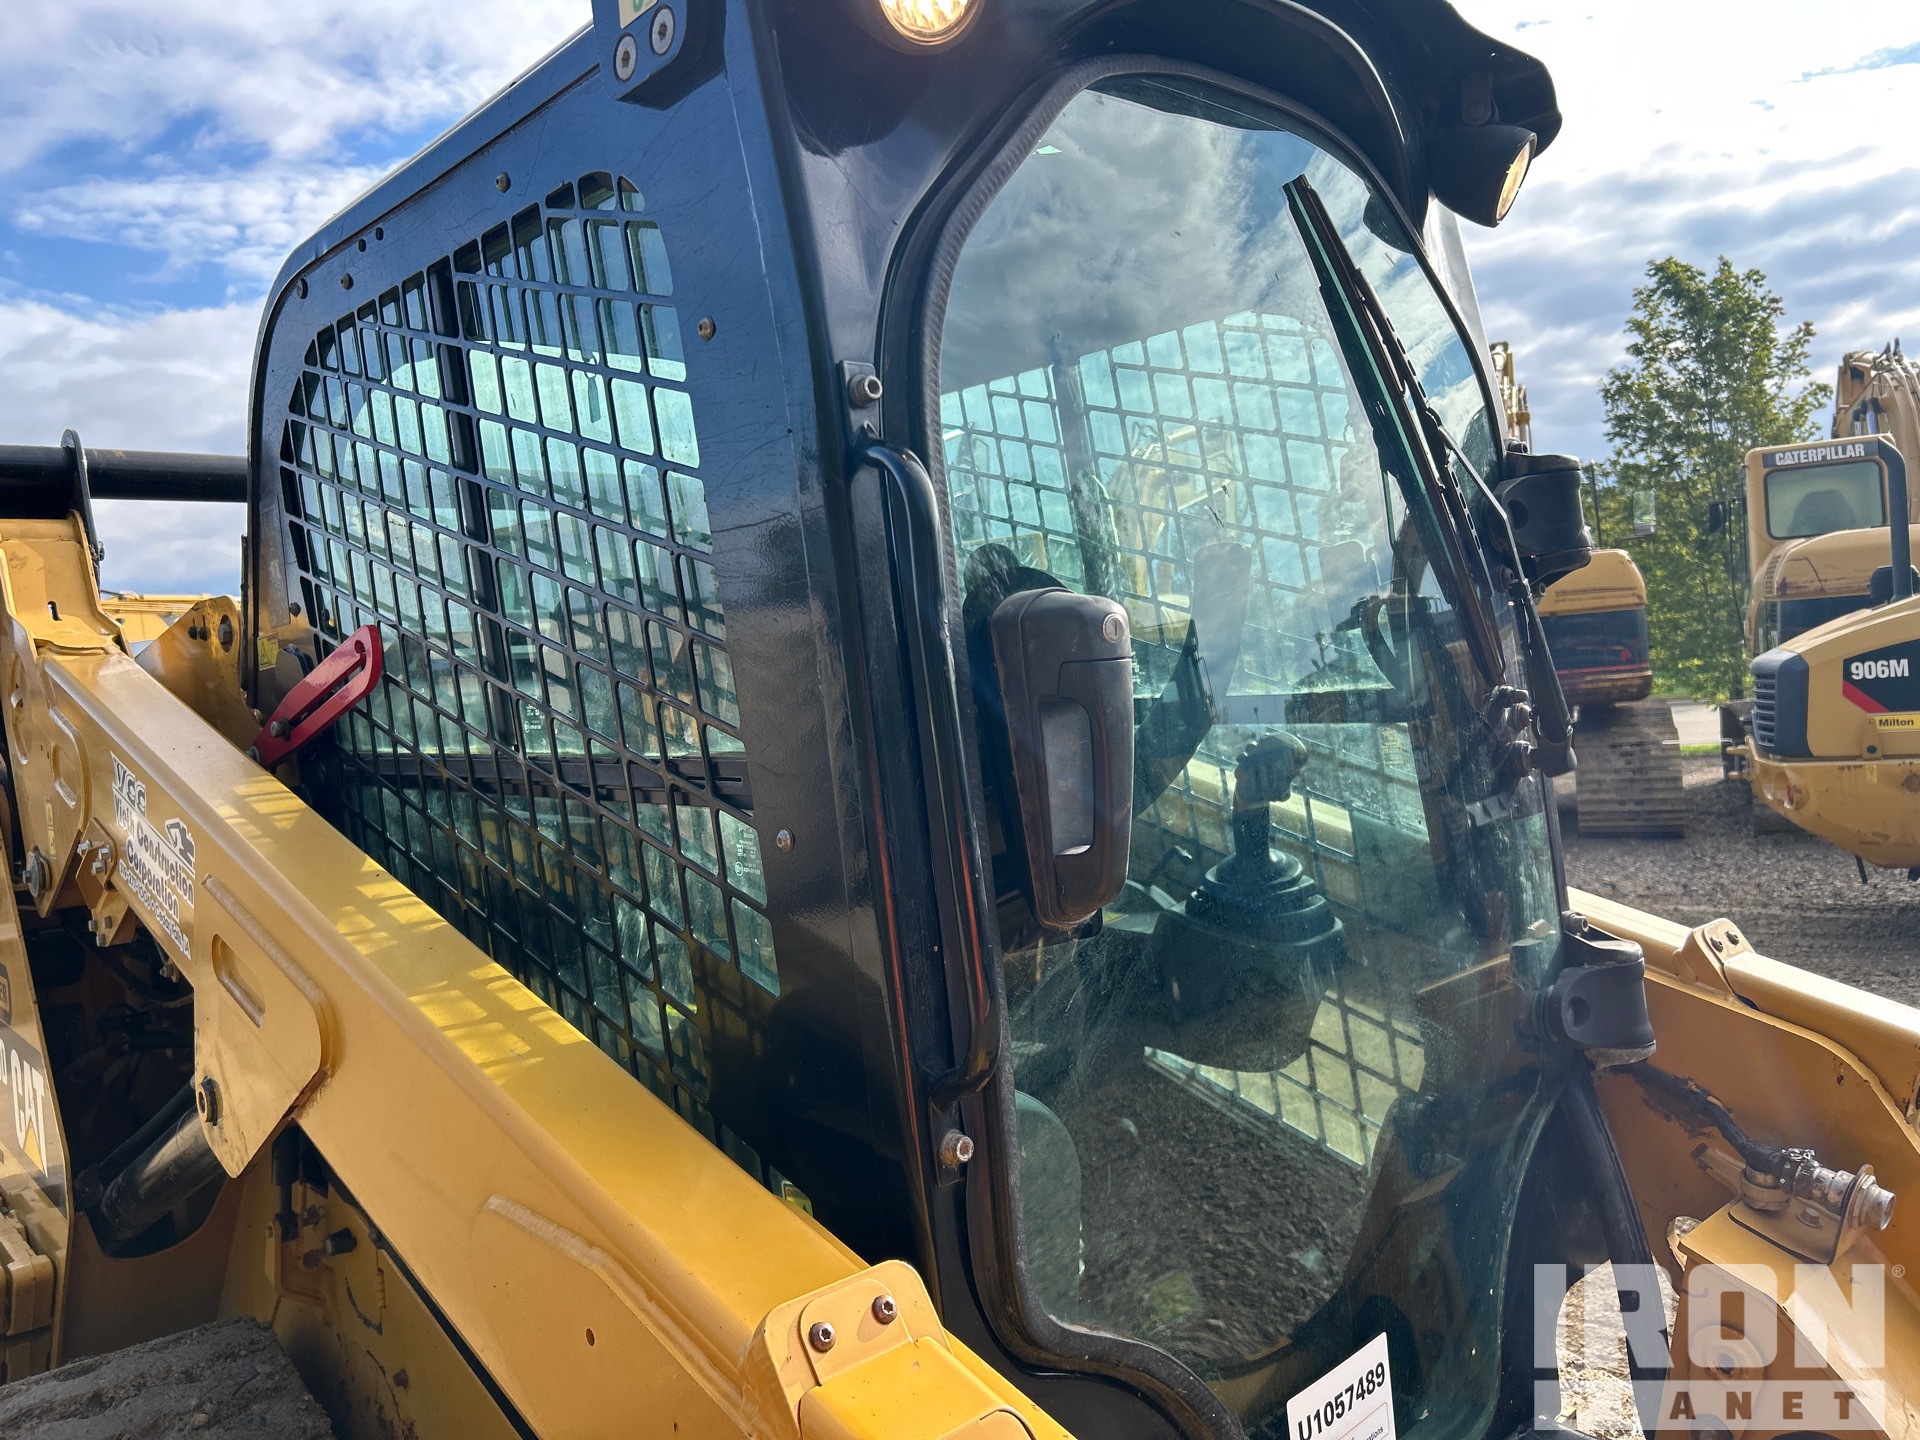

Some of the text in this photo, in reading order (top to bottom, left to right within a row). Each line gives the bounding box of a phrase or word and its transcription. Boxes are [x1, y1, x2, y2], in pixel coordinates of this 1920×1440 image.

[1775, 442, 1865, 466] CATERPILLAR
[1850, 658, 1909, 681] 906M
[1878, 717, 1914, 727] Milton
[126, 838, 180, 922] Corporation
[136, 820, 195, 906] Construction
[11, 1048, 49, 1178] CAT
[1297, 1361, 1386, 1440] U1057489
